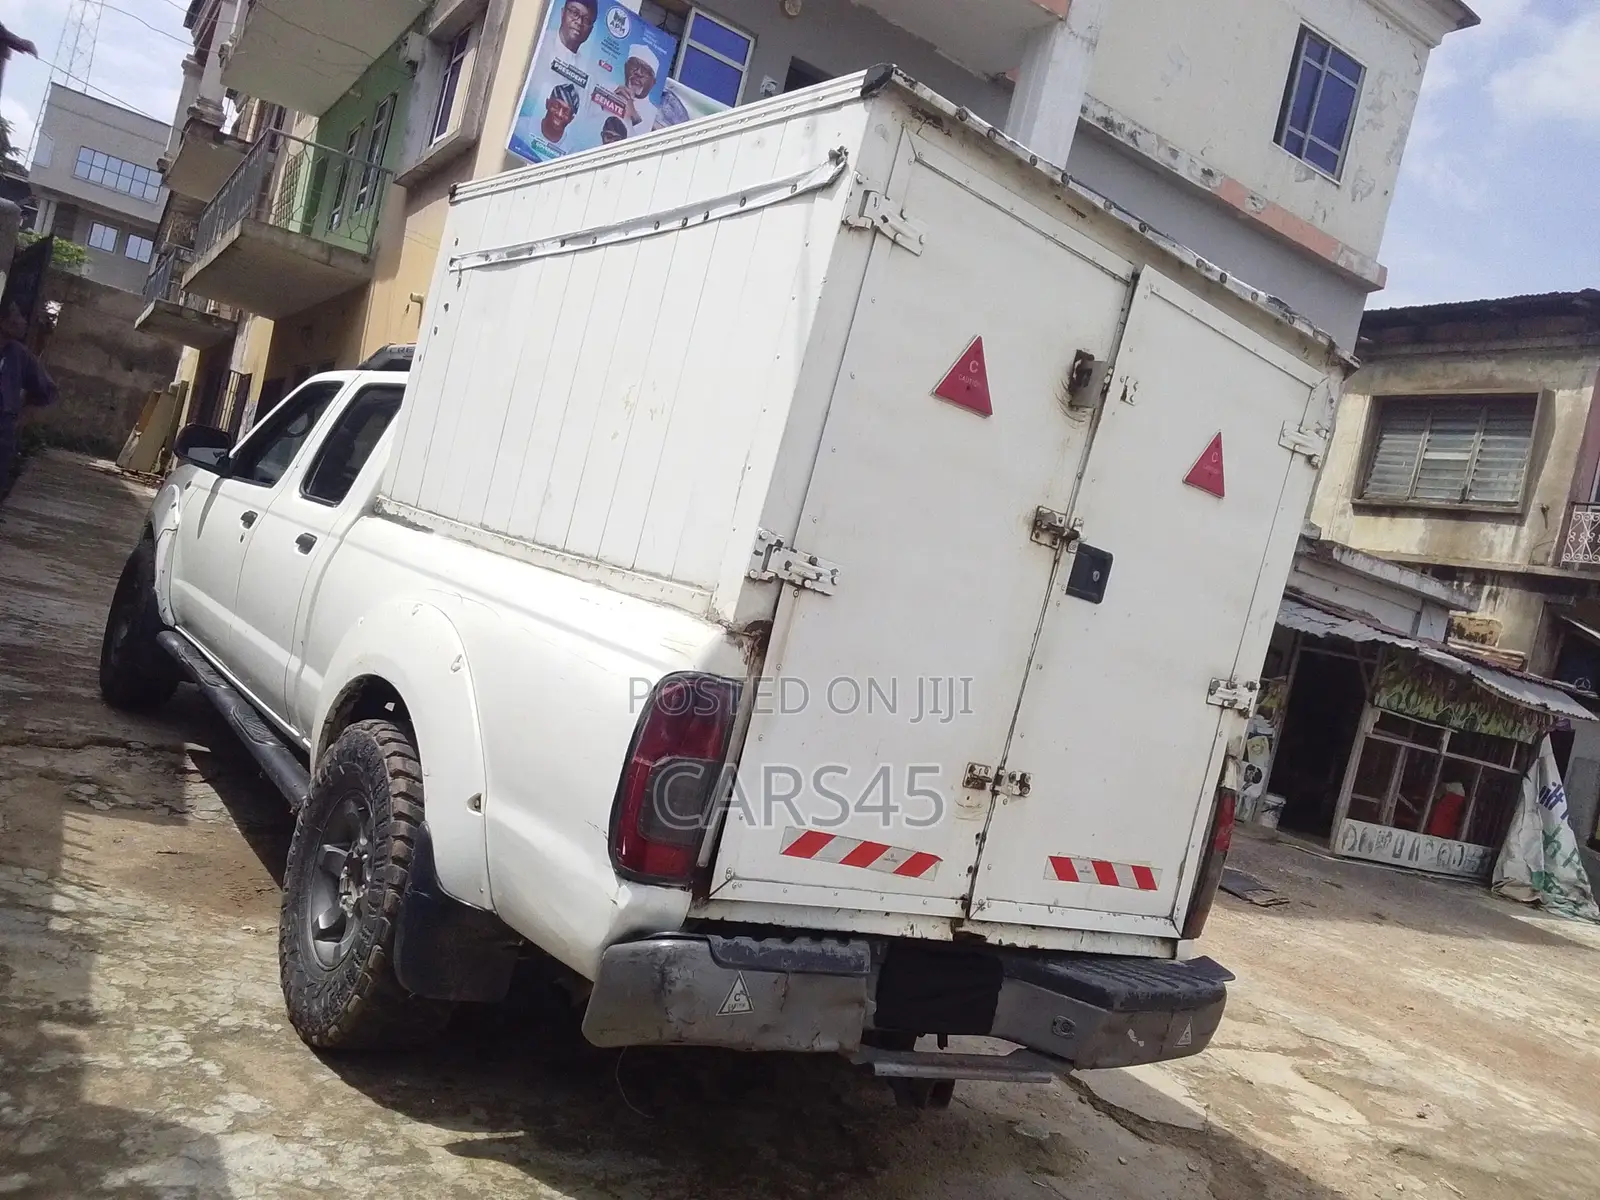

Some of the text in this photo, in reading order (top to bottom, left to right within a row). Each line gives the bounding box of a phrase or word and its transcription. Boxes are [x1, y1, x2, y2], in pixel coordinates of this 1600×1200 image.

[554, 62, 587, 85] PRESIDENT
[594, 93, 624, 115] SENATE
[969, 360, 979, 373] C
[734, 993, 741, 1002] C
